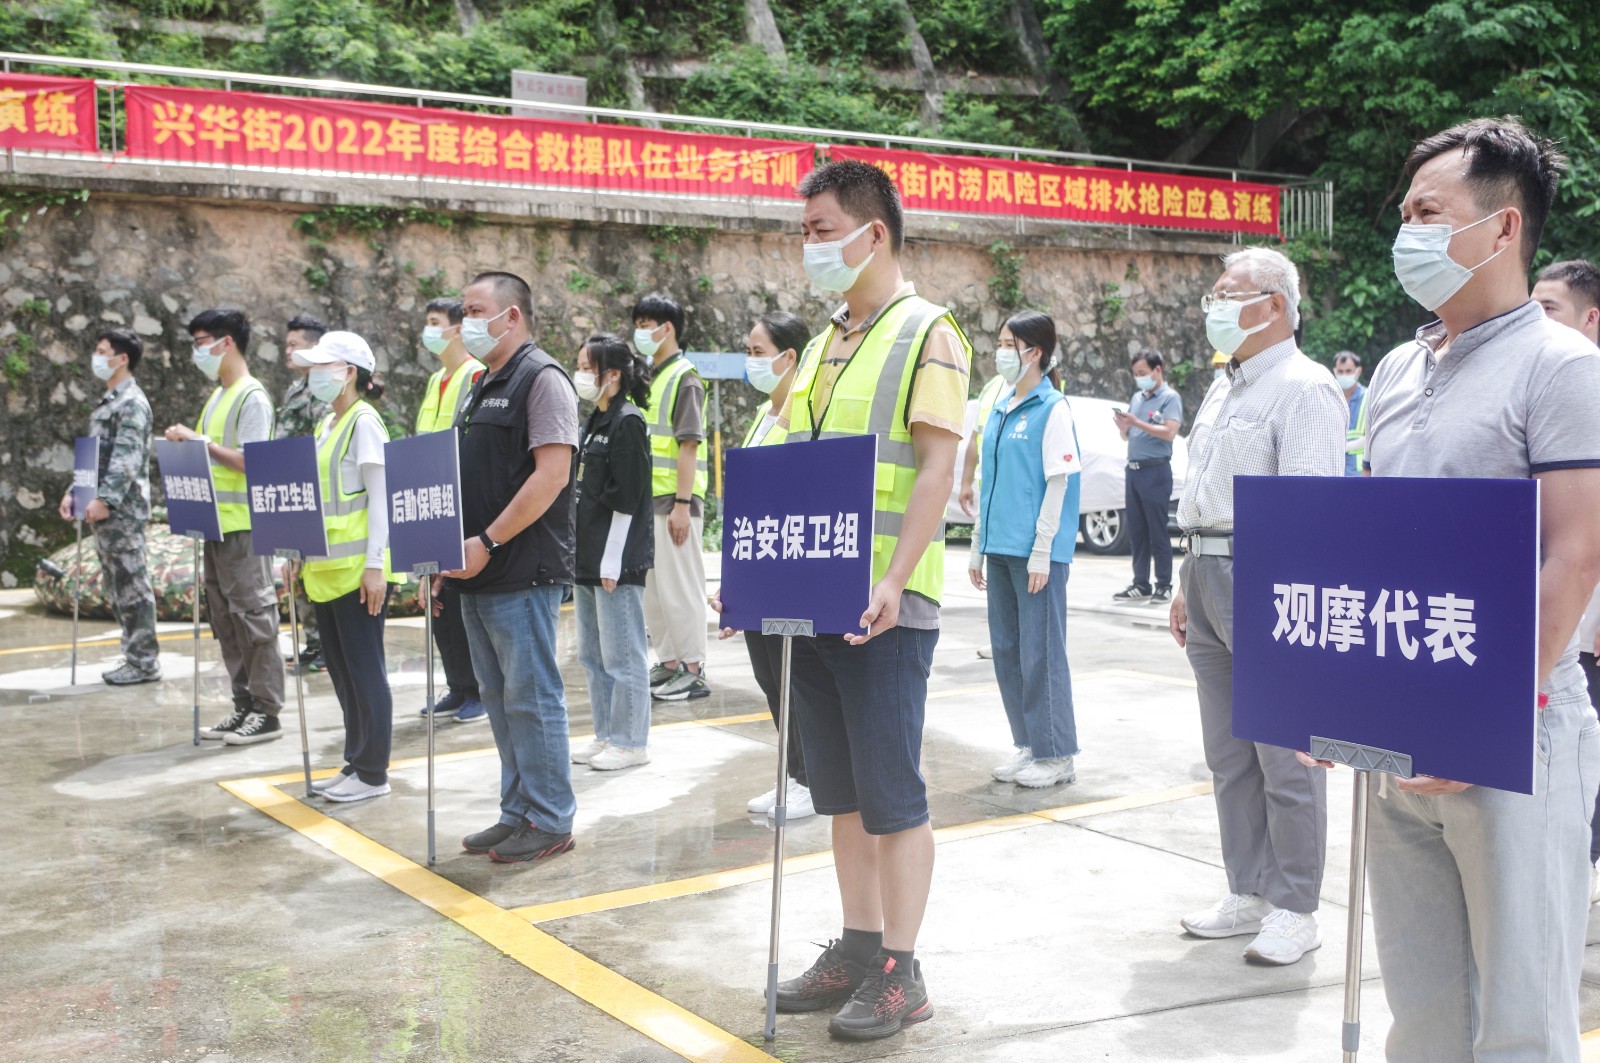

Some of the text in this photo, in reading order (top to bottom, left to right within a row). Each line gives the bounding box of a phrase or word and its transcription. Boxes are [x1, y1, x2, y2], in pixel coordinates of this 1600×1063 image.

[152, 101, 799, 189] 兴华街2022年度综合救援队伍业务培训
[860, 160, 1273, 225] 街内涝风险区域排水抢险应急演练
[251, 482, 317, 513] 医疗卫生组
[392, 484, 456, 524] 后勤保障组
[731, 511, 860, 561] 治安保卫组
[1271, 582, 1478, 667] 观摩代表
